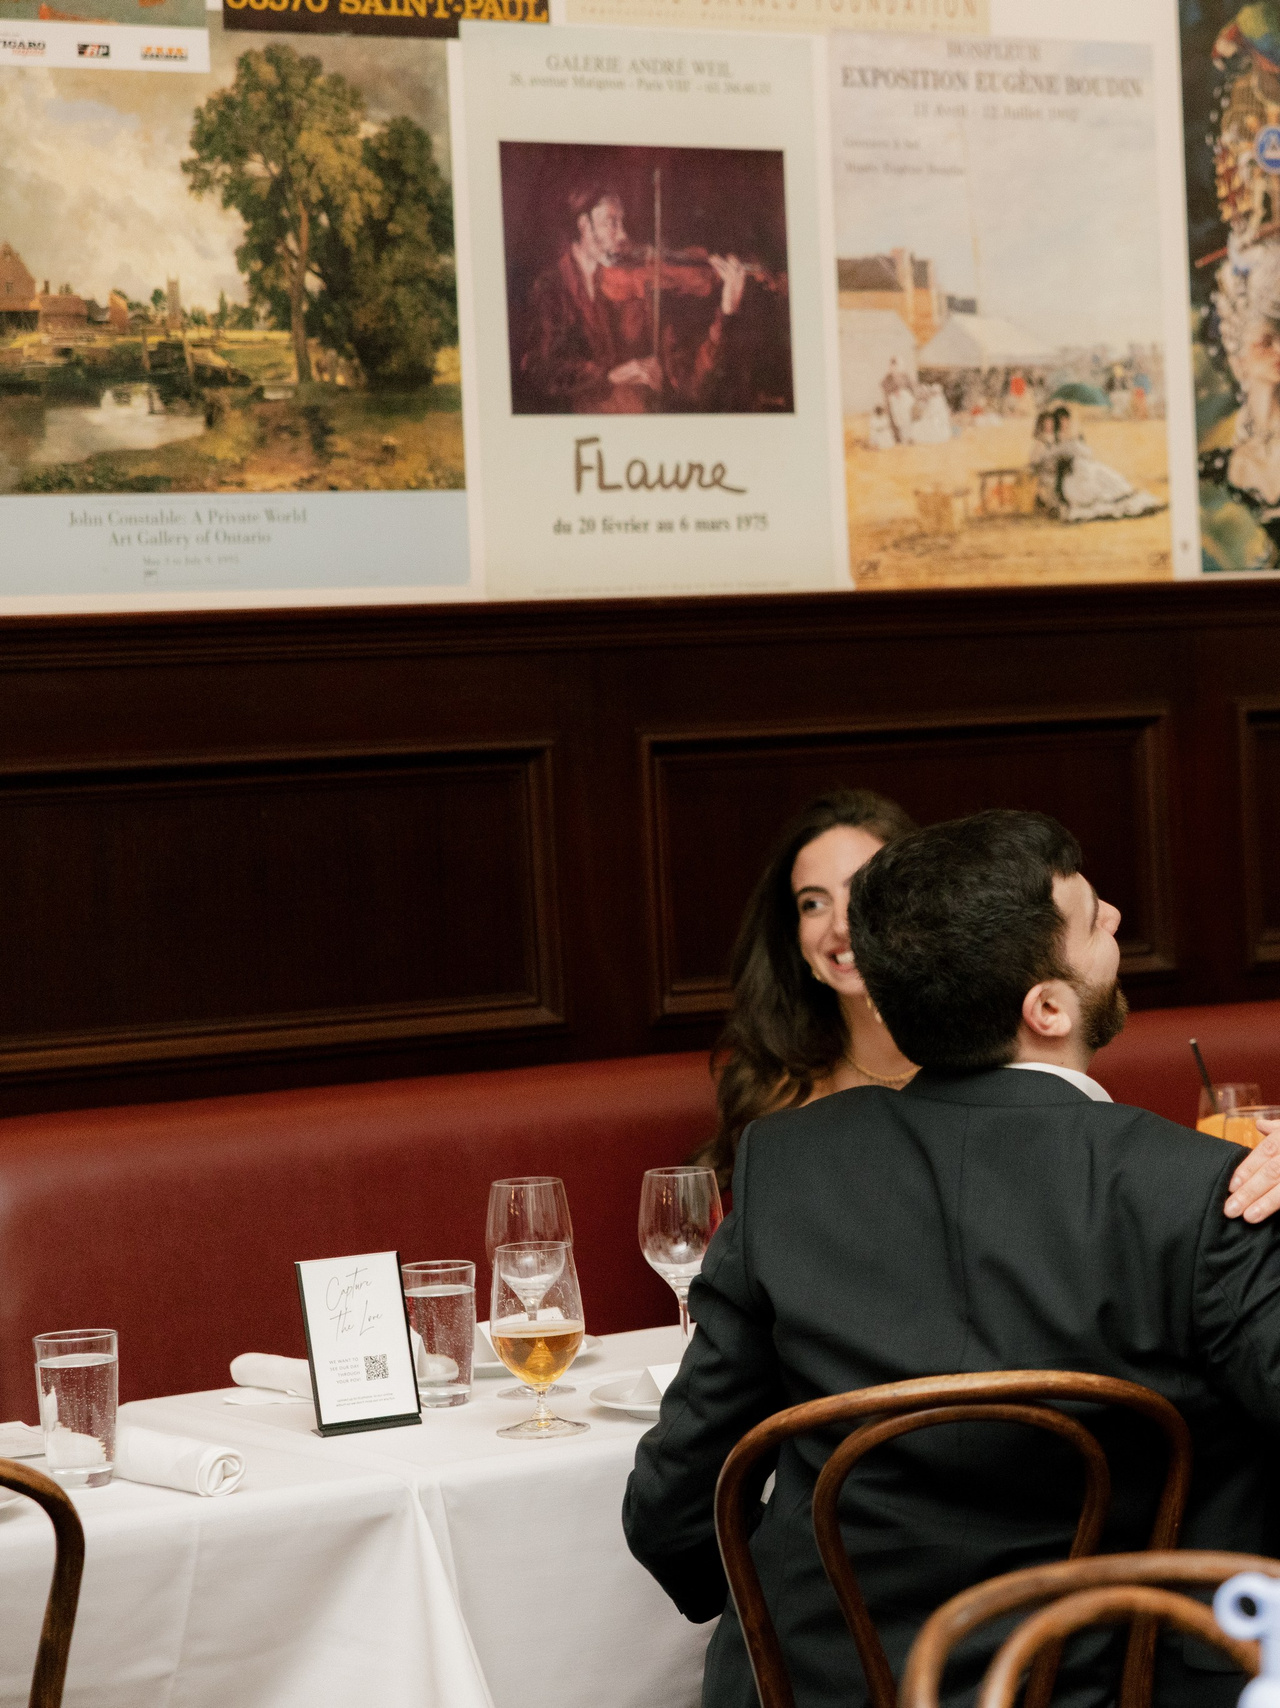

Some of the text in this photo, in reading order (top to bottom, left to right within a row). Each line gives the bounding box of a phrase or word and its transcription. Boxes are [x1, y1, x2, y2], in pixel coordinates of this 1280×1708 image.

[545, 54, 620, 74] GALERIE
[841, 65, 969, 92] EXPOSITION
[1064, 75, 1144, 99] BOUDIN
[68, 509, 103, 528] John
[191, 509, 202, 525] A
[208, 509, 259, 525] Private
[264, 507, 308, 524] World
[553, 516, 573, 535] du
[655, 519, 675, 533] au
[695, 519, 731, 533] mars
[109, 529, 272, 549] Art Gallery of Ontario
[326, 1267, 373, 1312] Capture
